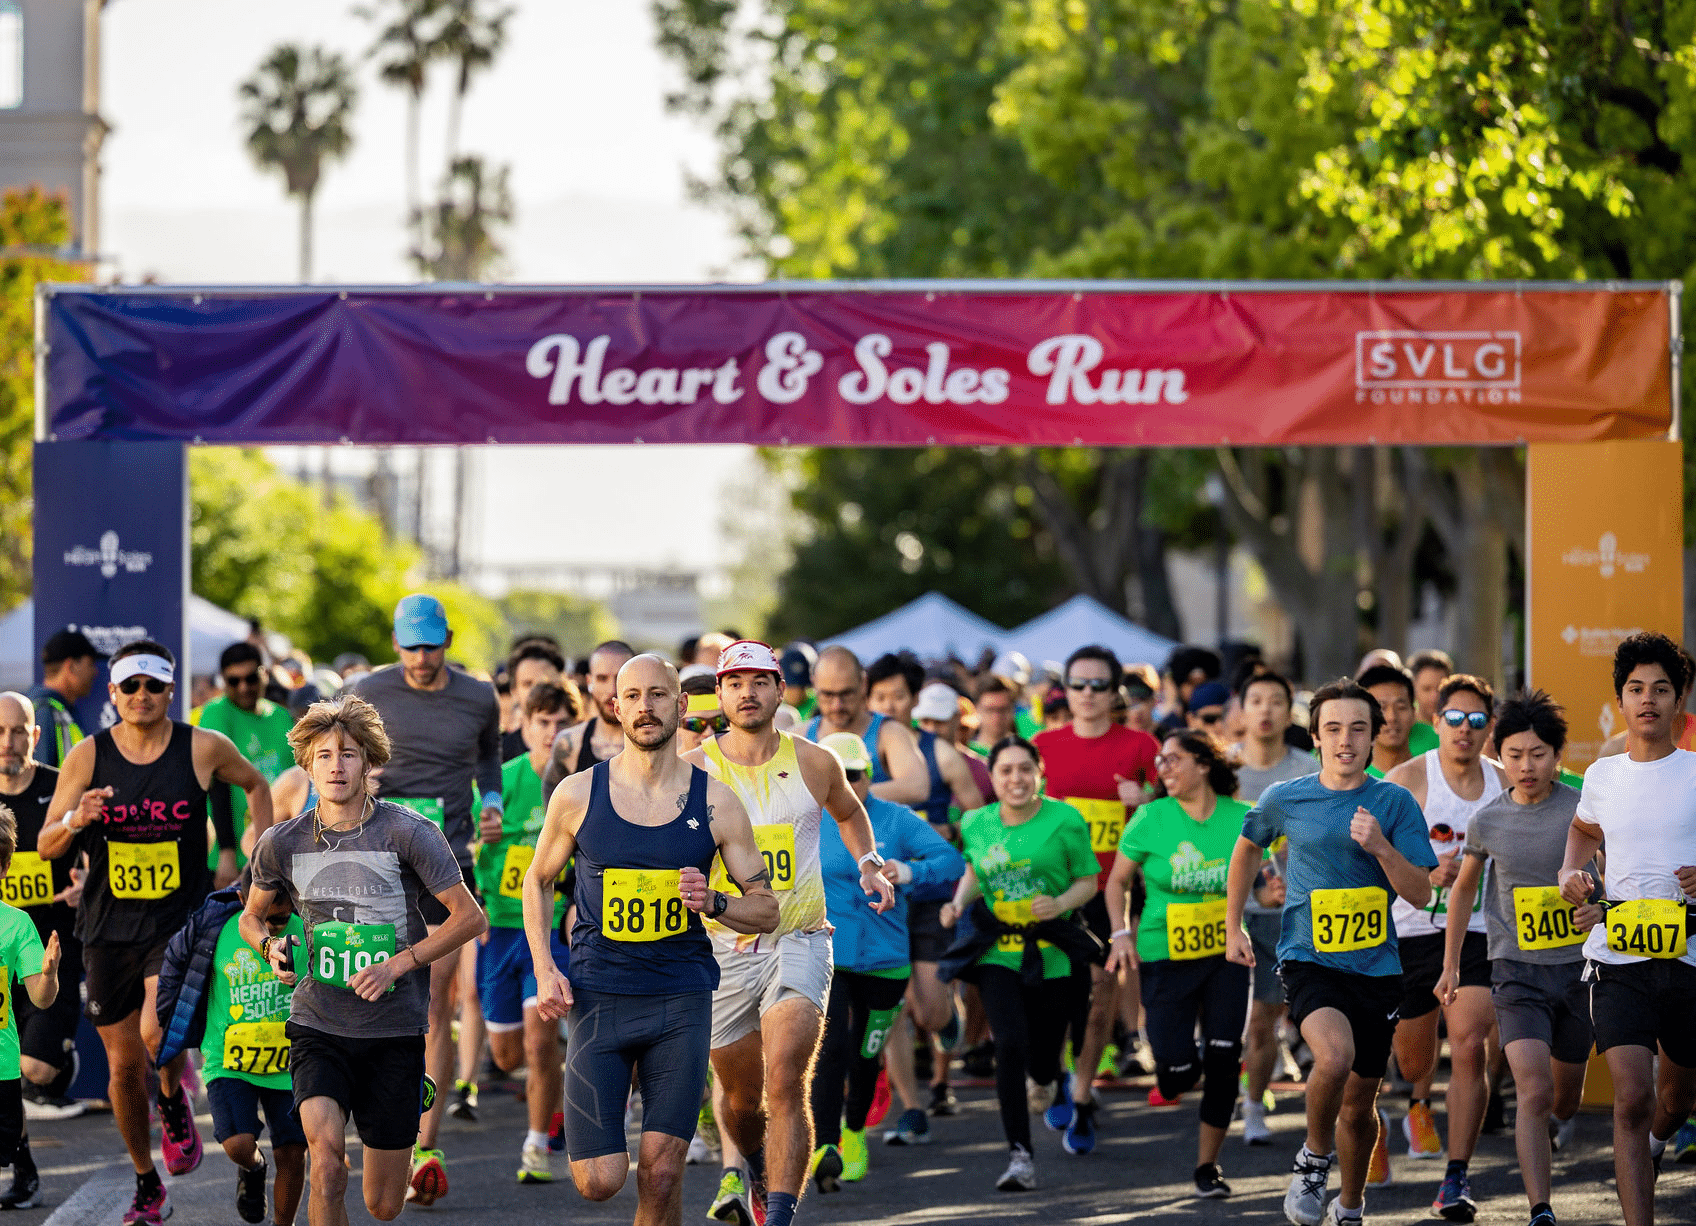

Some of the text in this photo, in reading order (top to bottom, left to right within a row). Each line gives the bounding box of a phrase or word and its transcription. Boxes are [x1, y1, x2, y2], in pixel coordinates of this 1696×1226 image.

[526, 331, 1187, 405] Heart & Soles Run
[1370, 343, 1506, 378] SVLG
[1355, 389, 1522, 404] FOUNDATION
[0, 873, 48, 900] 566
[115, 864, 174, 891] 3312
[313, 884, 384, 897] WEST COAST
[609, 897, 682, 933] 3818
[1318, 909, 1381, 944] 3729
[1173, 920, 1227, 953] 3385
[1612, 923, 1680, 953] 3407
[230, 980, 281, 1005] HEART
[244, 993, 292, 1021] SOLES
[229, 1045, 290, 1073] 3770
